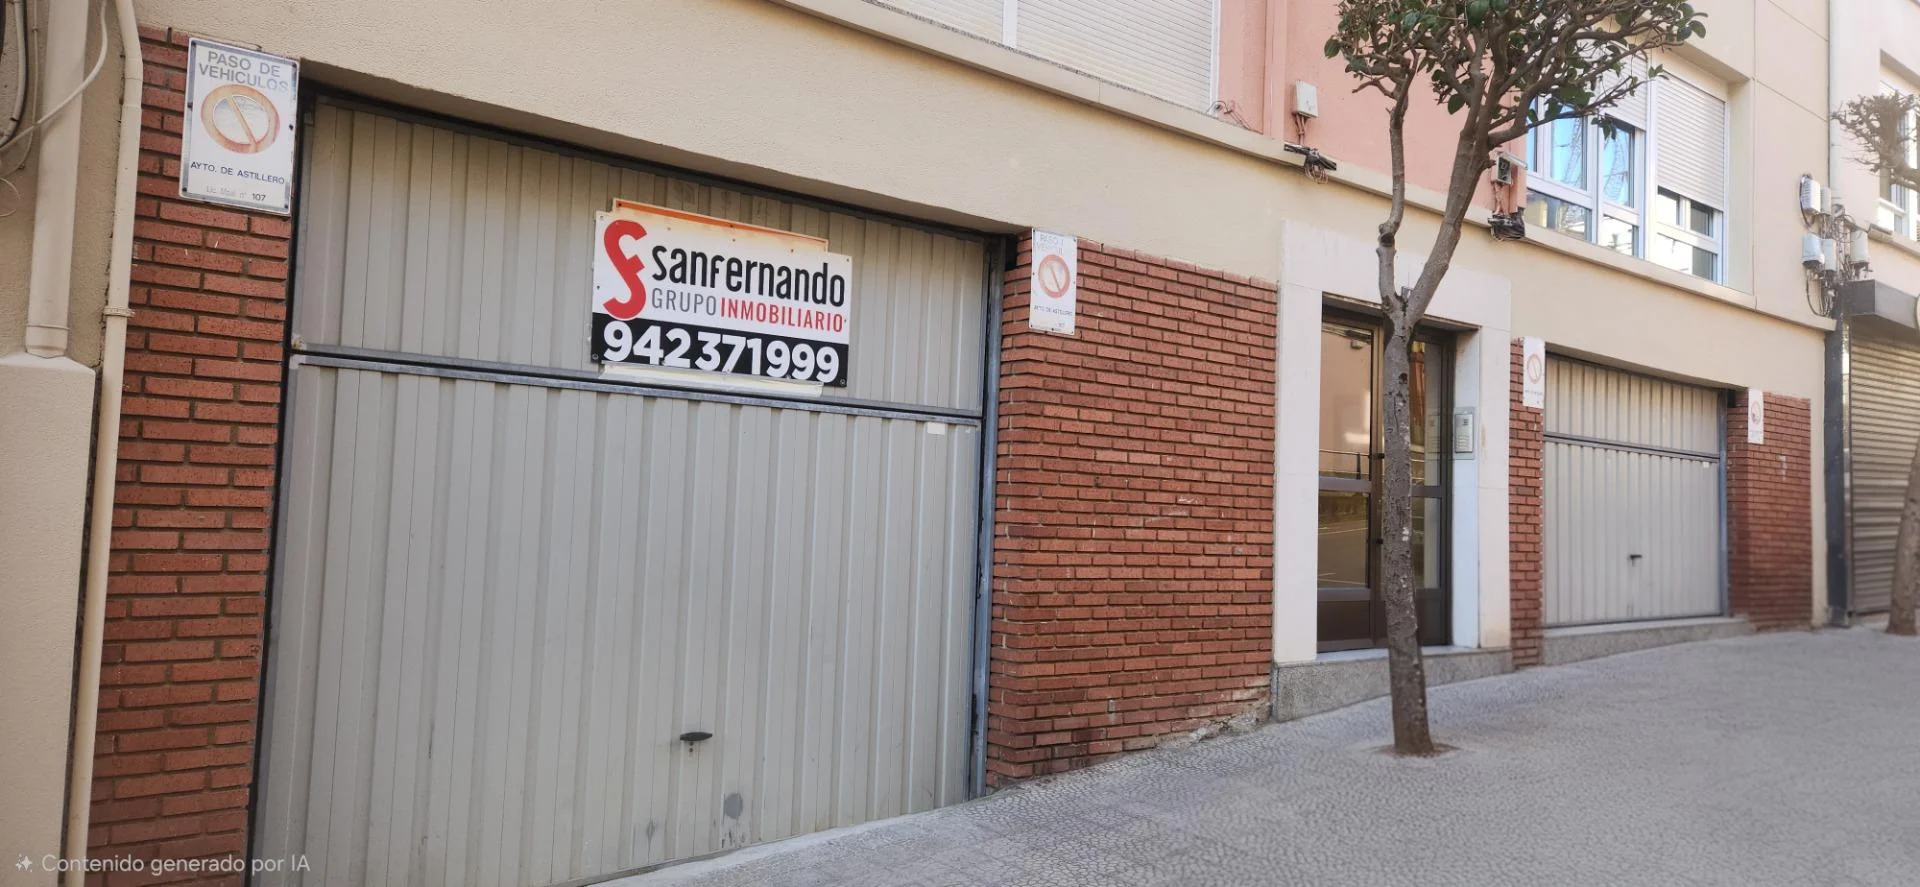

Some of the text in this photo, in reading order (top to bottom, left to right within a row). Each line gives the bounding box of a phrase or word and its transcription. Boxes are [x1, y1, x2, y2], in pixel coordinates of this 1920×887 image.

[198, 63, 289, 93] VEHICULOS
[207, 50, 281, 78] PASO DE
[190, 161, 285, 185] AYTO. DE ASTILLERO
[252, 193, 266, 201] 107
[651, 287, 843, 333] GRUPO INMOBILIARIO
